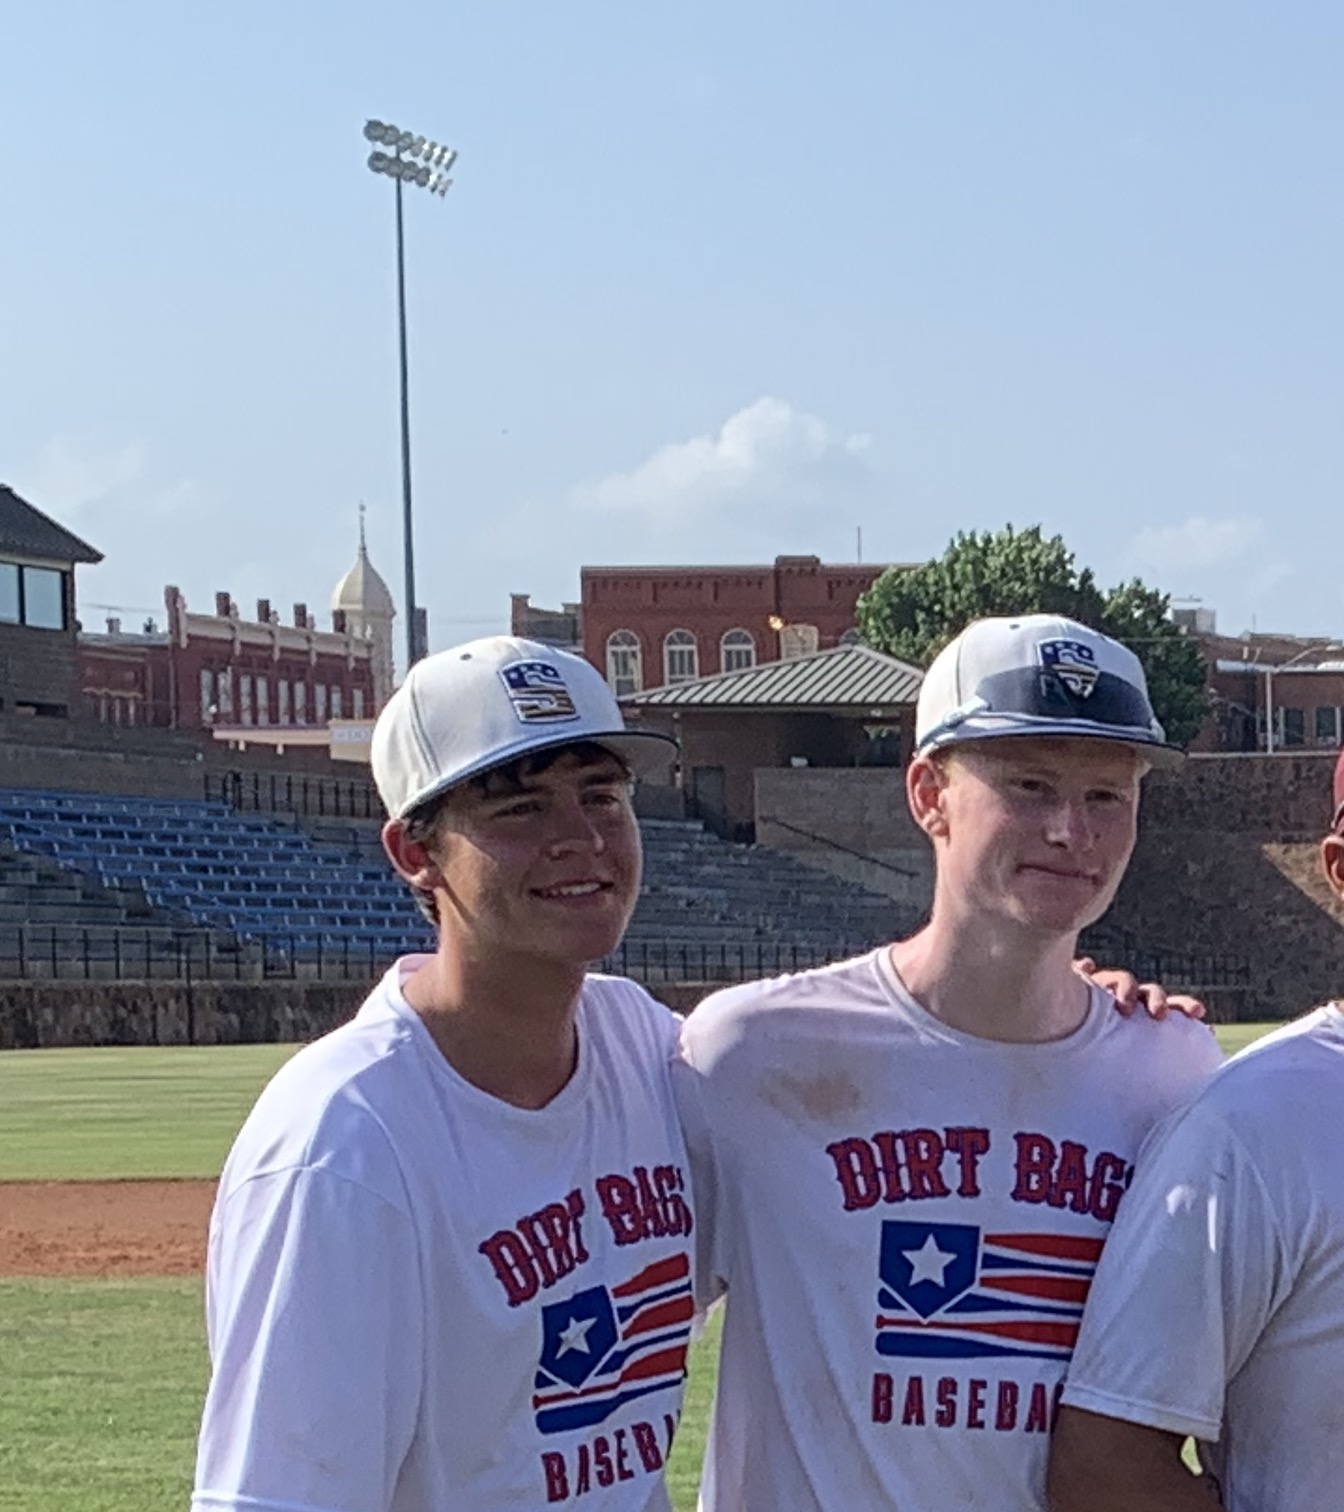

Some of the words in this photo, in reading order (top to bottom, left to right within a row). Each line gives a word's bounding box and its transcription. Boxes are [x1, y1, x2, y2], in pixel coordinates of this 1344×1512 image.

[826, 1127, 991, 1212] DIRT
[1010, 1131, 1135, 1223] BAG
[478, 1188, 589, 1308] DIRT
[872, 1372, 1064, 1433] BASEBA
